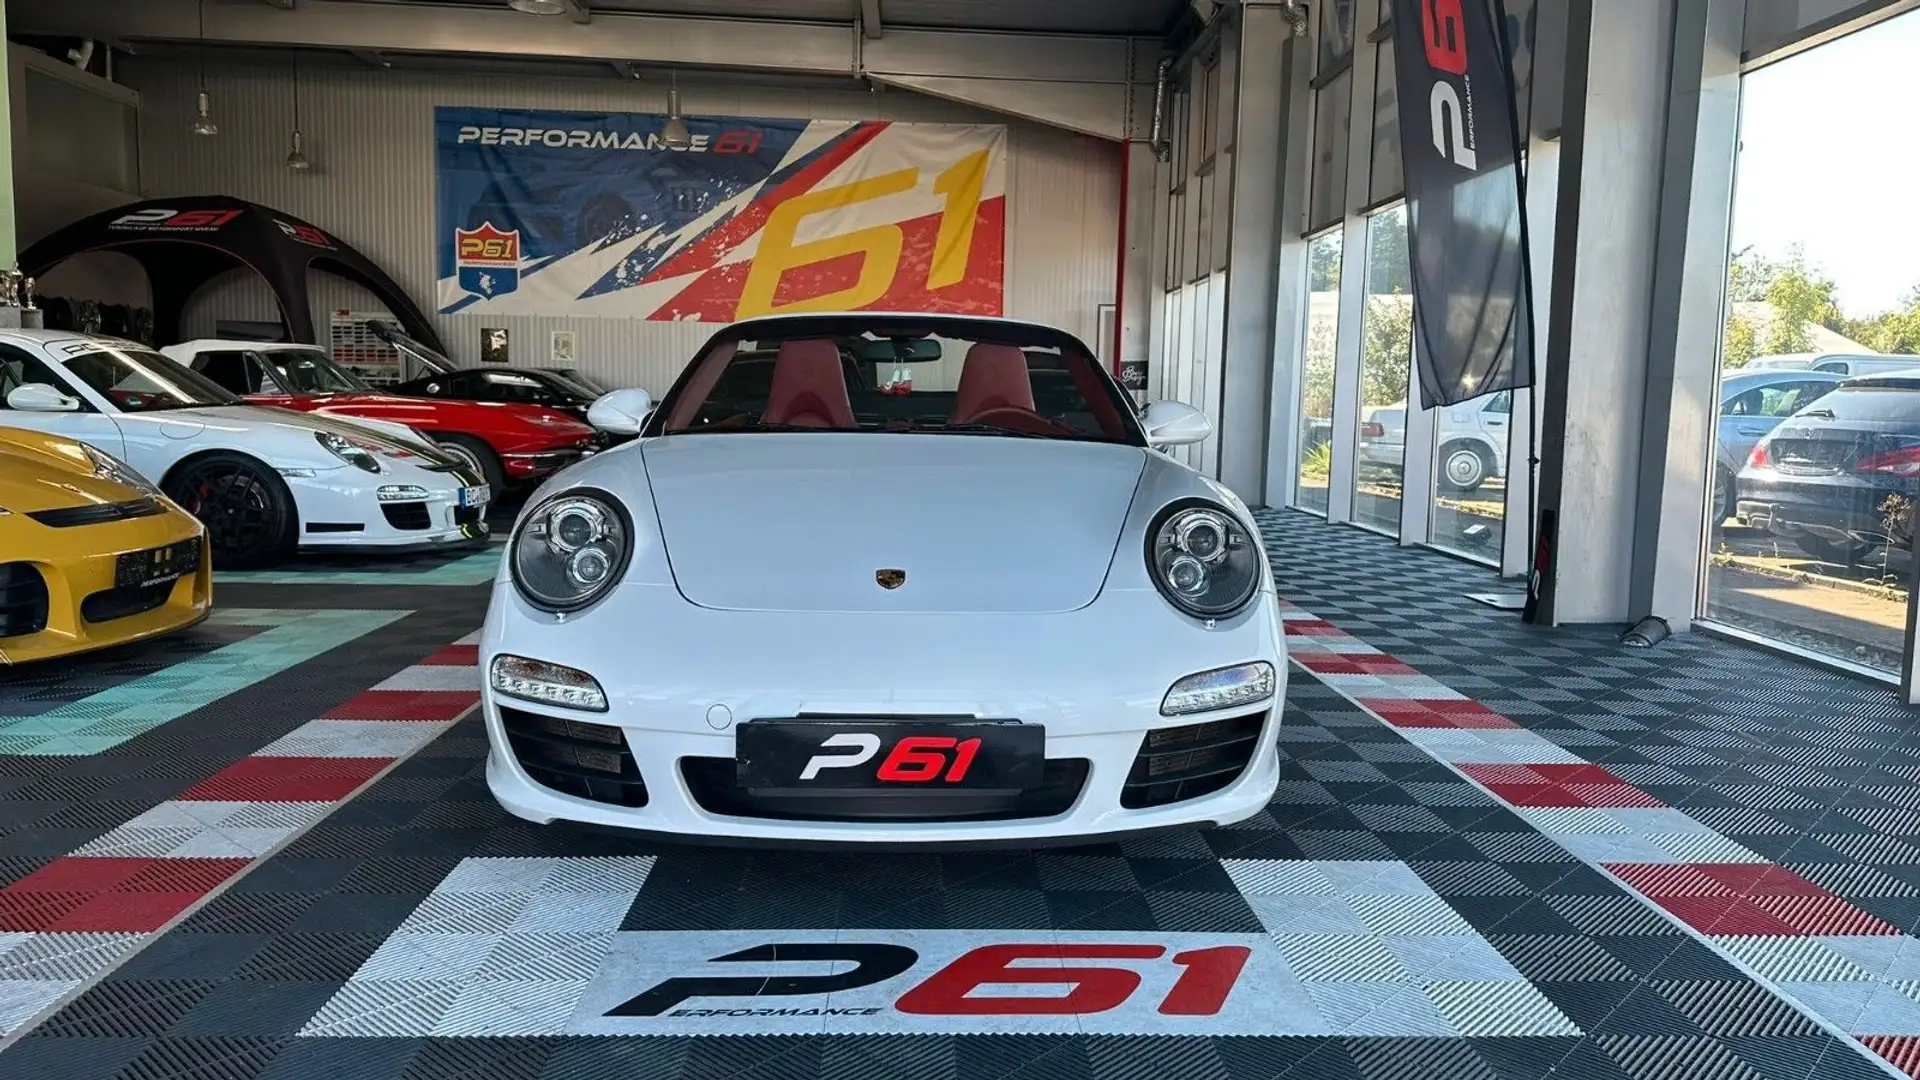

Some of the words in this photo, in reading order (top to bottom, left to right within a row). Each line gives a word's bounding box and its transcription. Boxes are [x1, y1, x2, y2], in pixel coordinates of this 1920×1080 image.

[457, 126, 709, 153] PERFORMANE
[713, 130, 763, 155] 61
[110, 208, 244, 226] P61
[460, 238, 513, 258] P61
[734, 148, 990, 321] 61
[799, 733, 982, 783] P61
[602, 943, 1251, 1017] P61
[667, 1007, 884, 1018] ERFORMANCE
